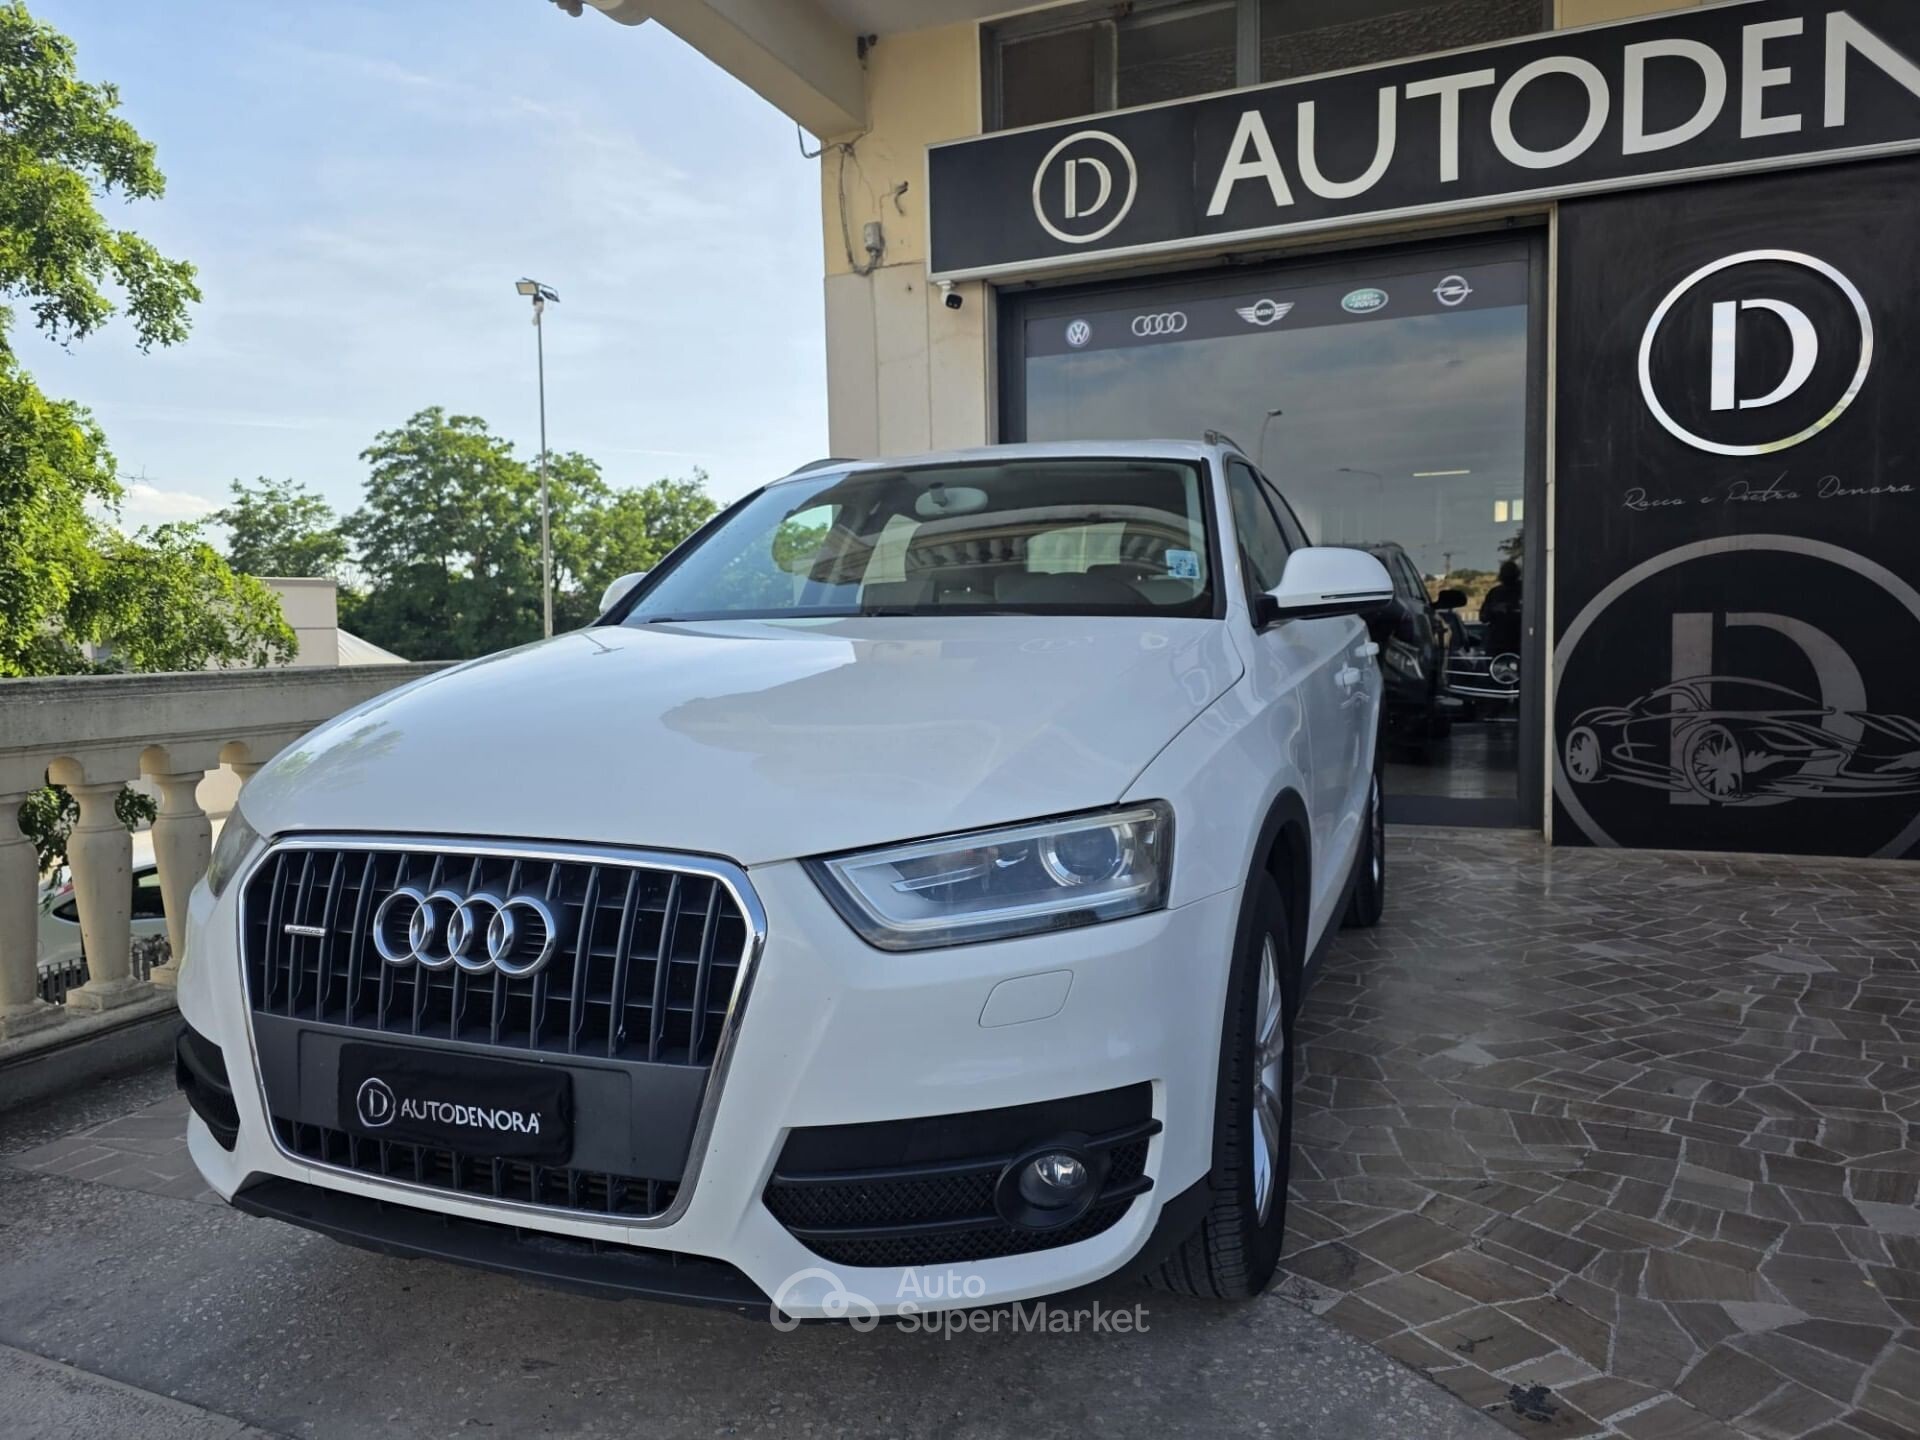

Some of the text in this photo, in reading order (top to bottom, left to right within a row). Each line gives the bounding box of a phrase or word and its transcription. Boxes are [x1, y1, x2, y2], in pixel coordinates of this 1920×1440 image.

[1064, 157, 1112, 219] D
[1710, 297, 1819, 411] D
[368, 1088, 540, 1135] D AUTODENORA
